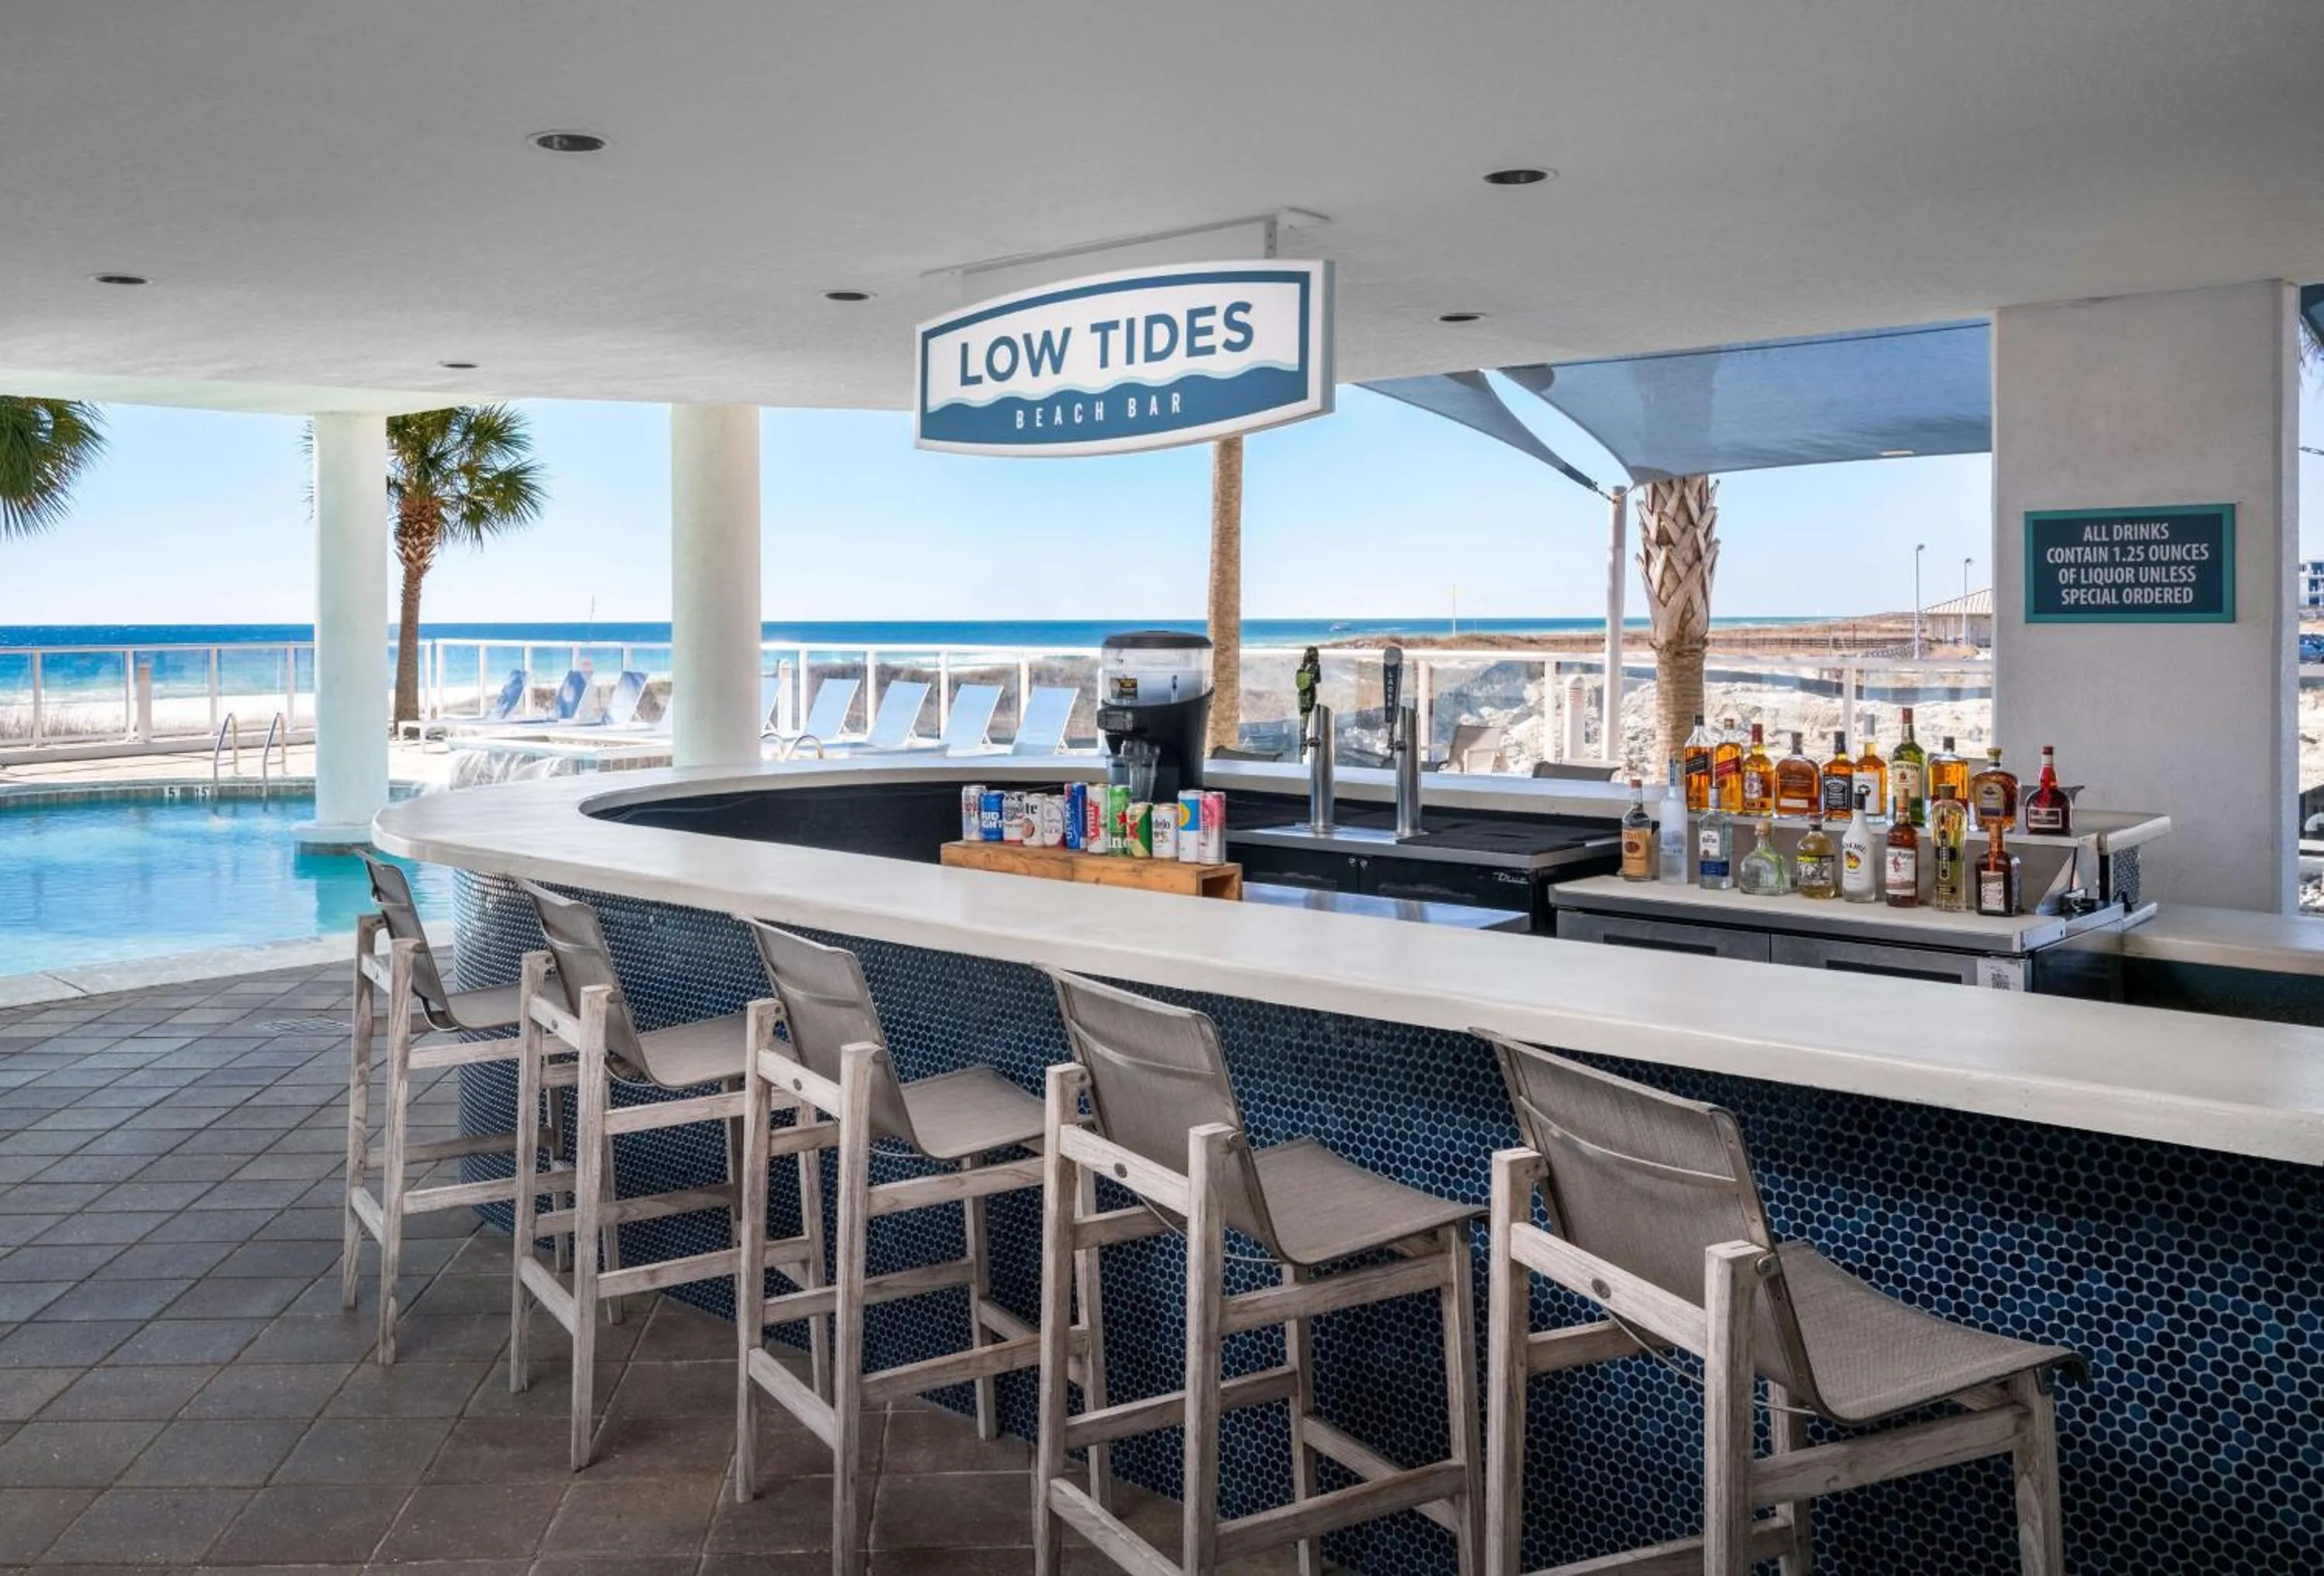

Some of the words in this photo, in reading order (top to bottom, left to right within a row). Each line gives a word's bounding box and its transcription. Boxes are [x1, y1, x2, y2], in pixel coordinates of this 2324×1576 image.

[960, 327, 1072, 387] LOW
[1090, 301, 1254, 370] TIDES
[1016, 401, 1104, 430] BEACH
[1128, 393, 1181, 420] BAR
[2083, 525, 2109, 542] ALL
[2113, 523, 2170, 542] DRINKS
[2047, 546, 2109, 564] CONTAIN
[2113, 545, 2145, 563] 1.25
[2148, 543, 2209, 562] OUNCES
[2058, 568, 2078, 585] OF
[2081, 566, 2135, 586] LIQUOR
[2139, 566, 2196, 583] UNLESS
[2061, 588, 2119, 605] SPECIAL
[2123, 587, 2194, 604] ORDERED
